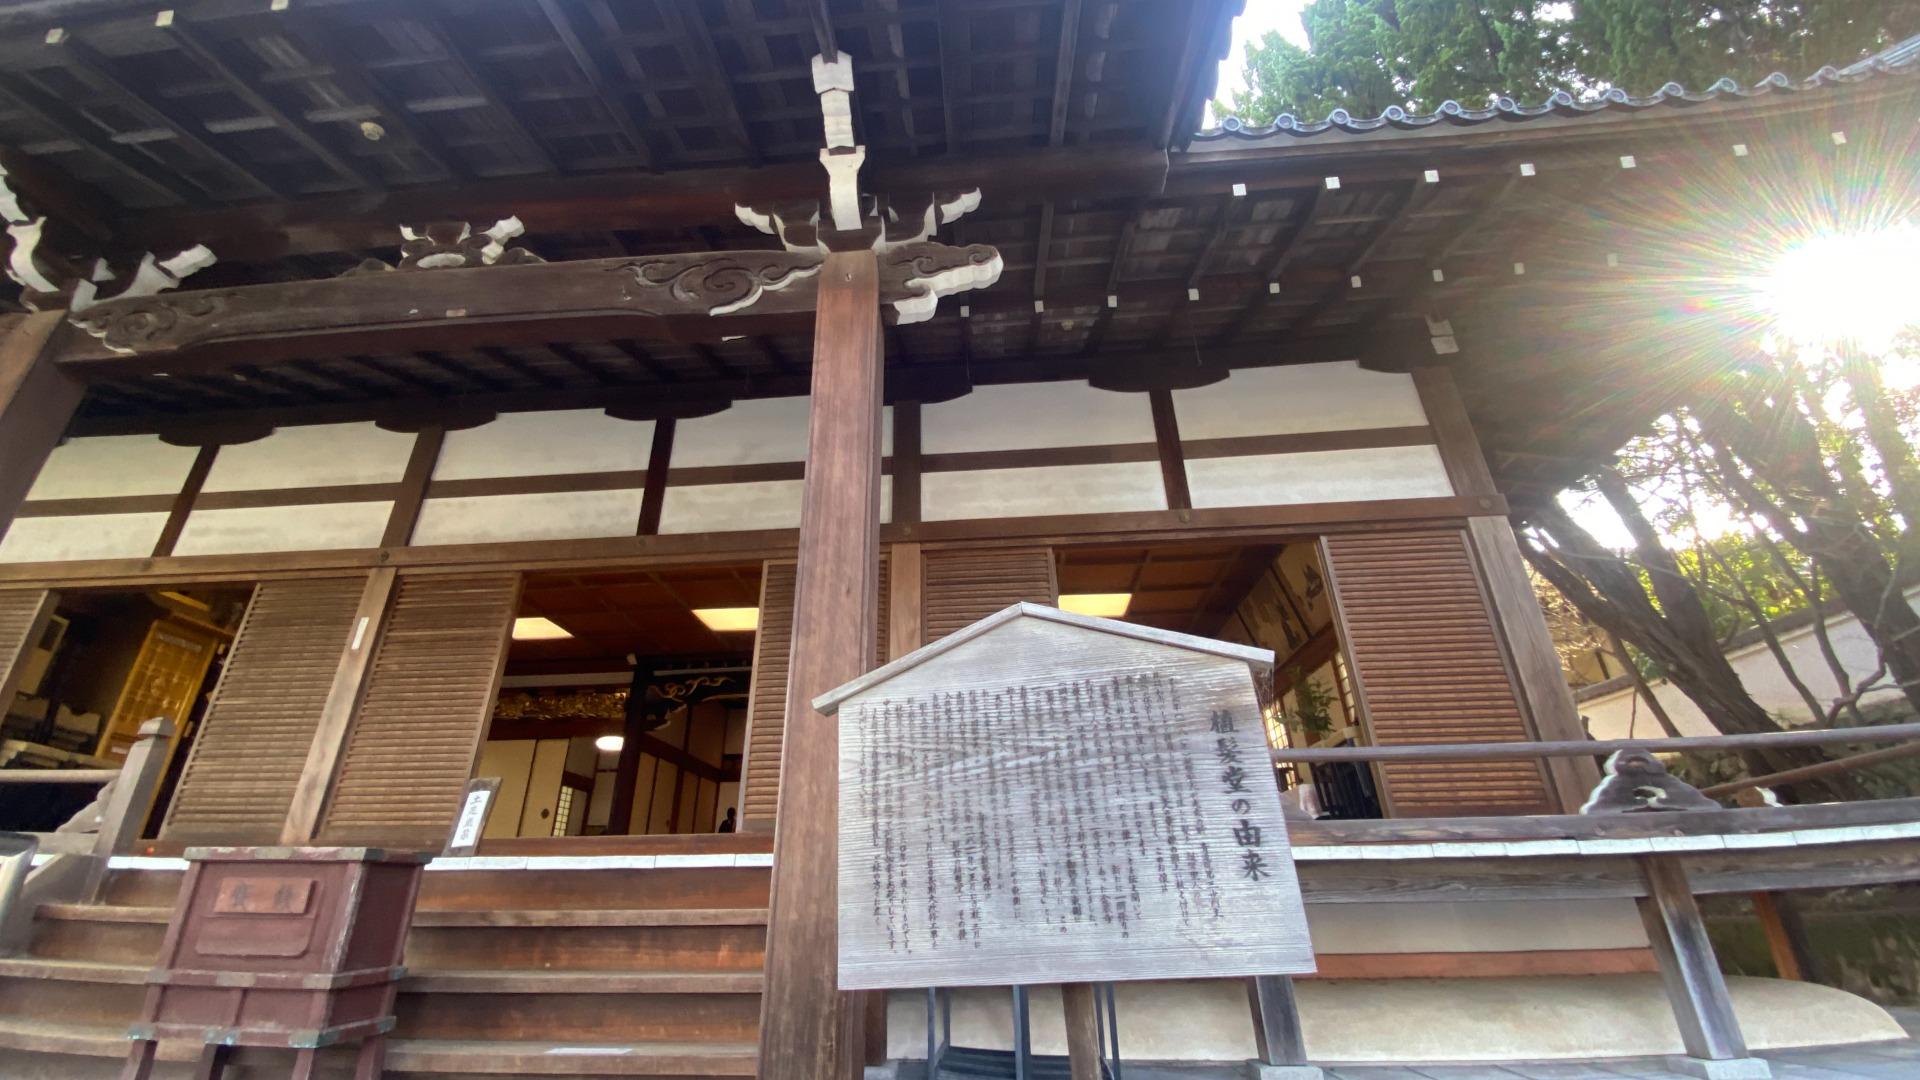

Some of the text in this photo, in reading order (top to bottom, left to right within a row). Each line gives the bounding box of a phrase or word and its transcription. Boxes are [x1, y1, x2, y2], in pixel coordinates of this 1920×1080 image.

[1210, 709, 1271, 881] 植髪堂の由来
